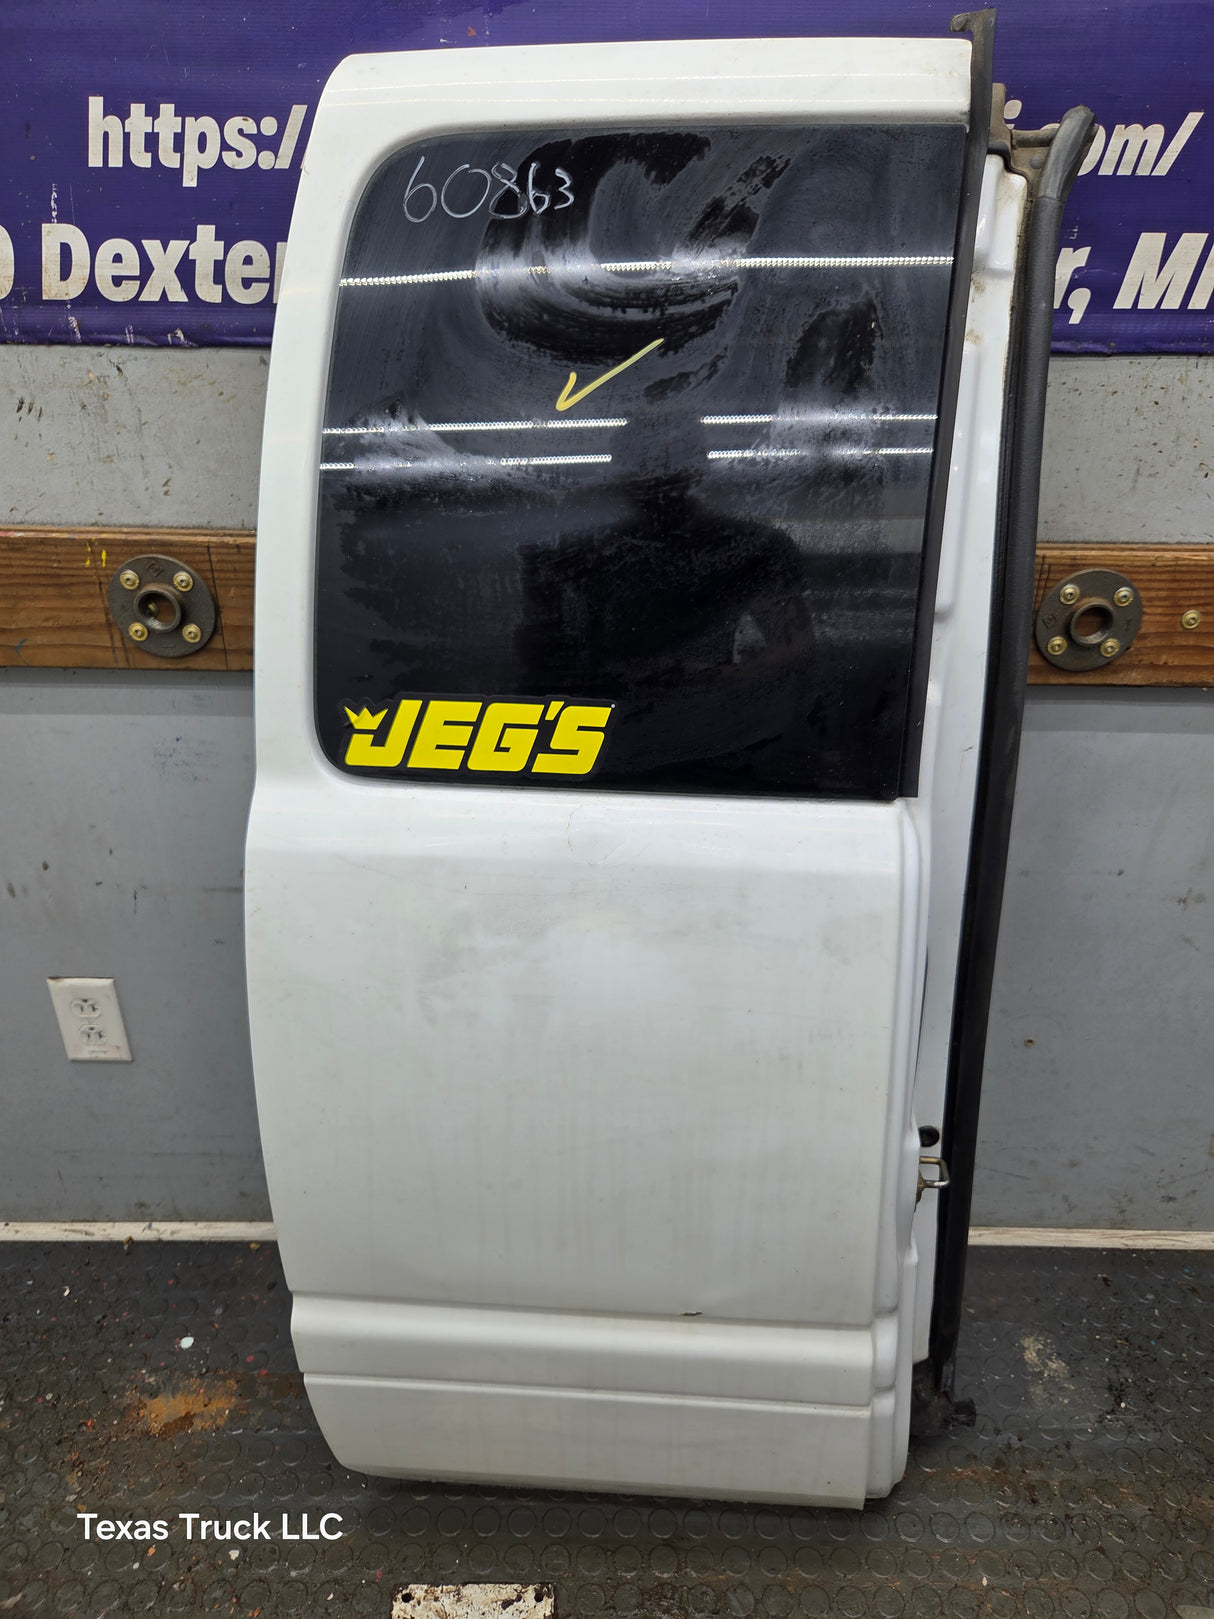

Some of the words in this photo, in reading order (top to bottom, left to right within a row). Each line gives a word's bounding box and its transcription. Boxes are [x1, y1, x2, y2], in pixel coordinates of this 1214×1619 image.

[88, 96, 309, 187] https:/
[403, 155, 575, 223] 60863
[345, 699, 612, 775] JEG'S
